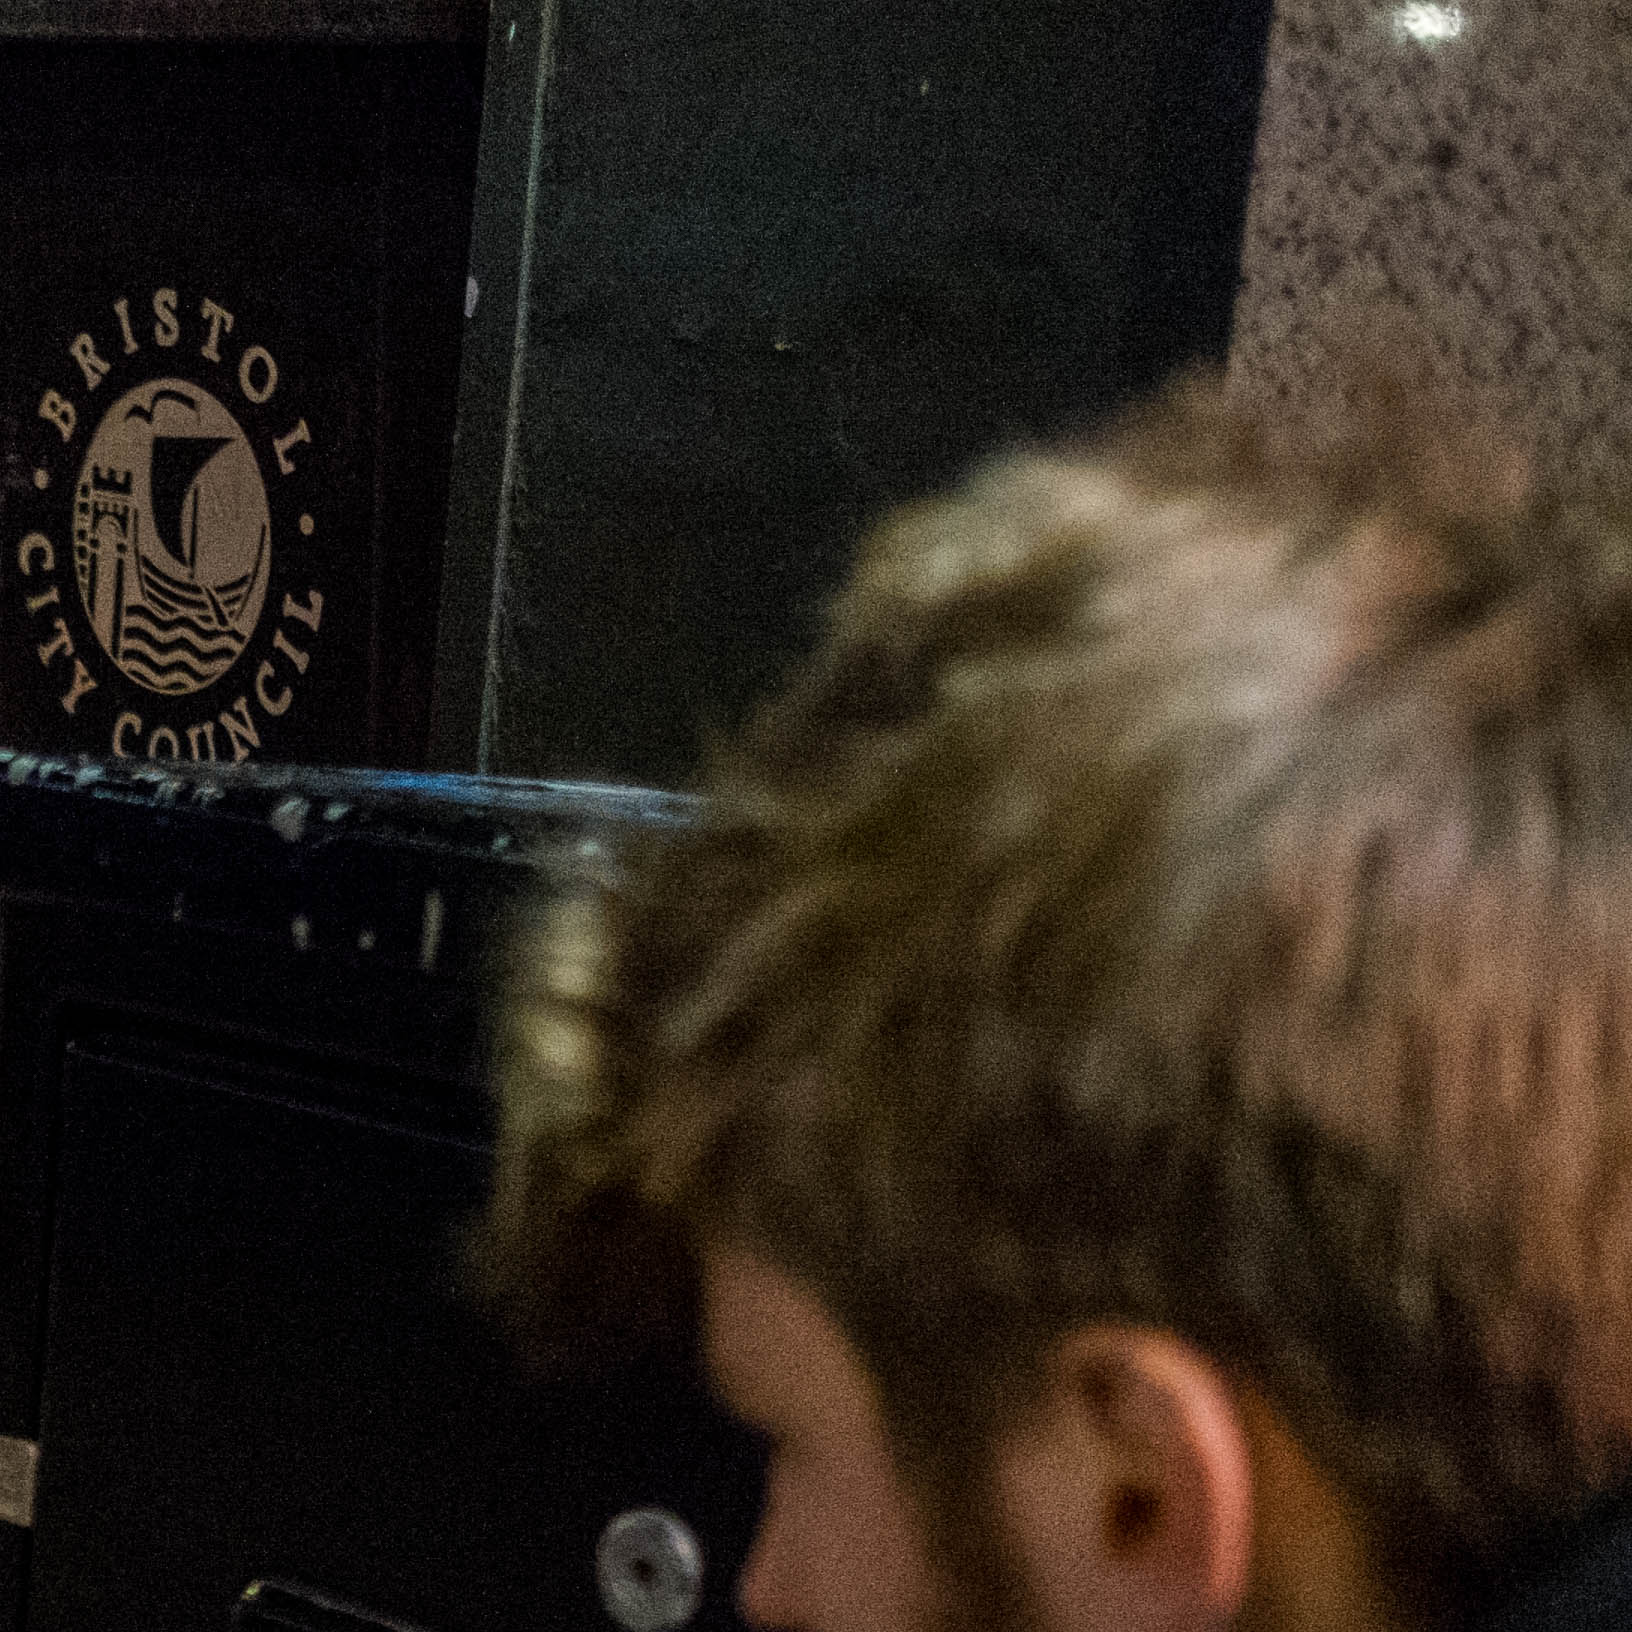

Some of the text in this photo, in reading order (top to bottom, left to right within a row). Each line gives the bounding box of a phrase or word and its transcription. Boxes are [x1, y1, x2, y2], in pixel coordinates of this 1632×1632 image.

[38, 286, 313, 476] BRISTOL
[17, 532, 325, 763] CITY COUNCIL
